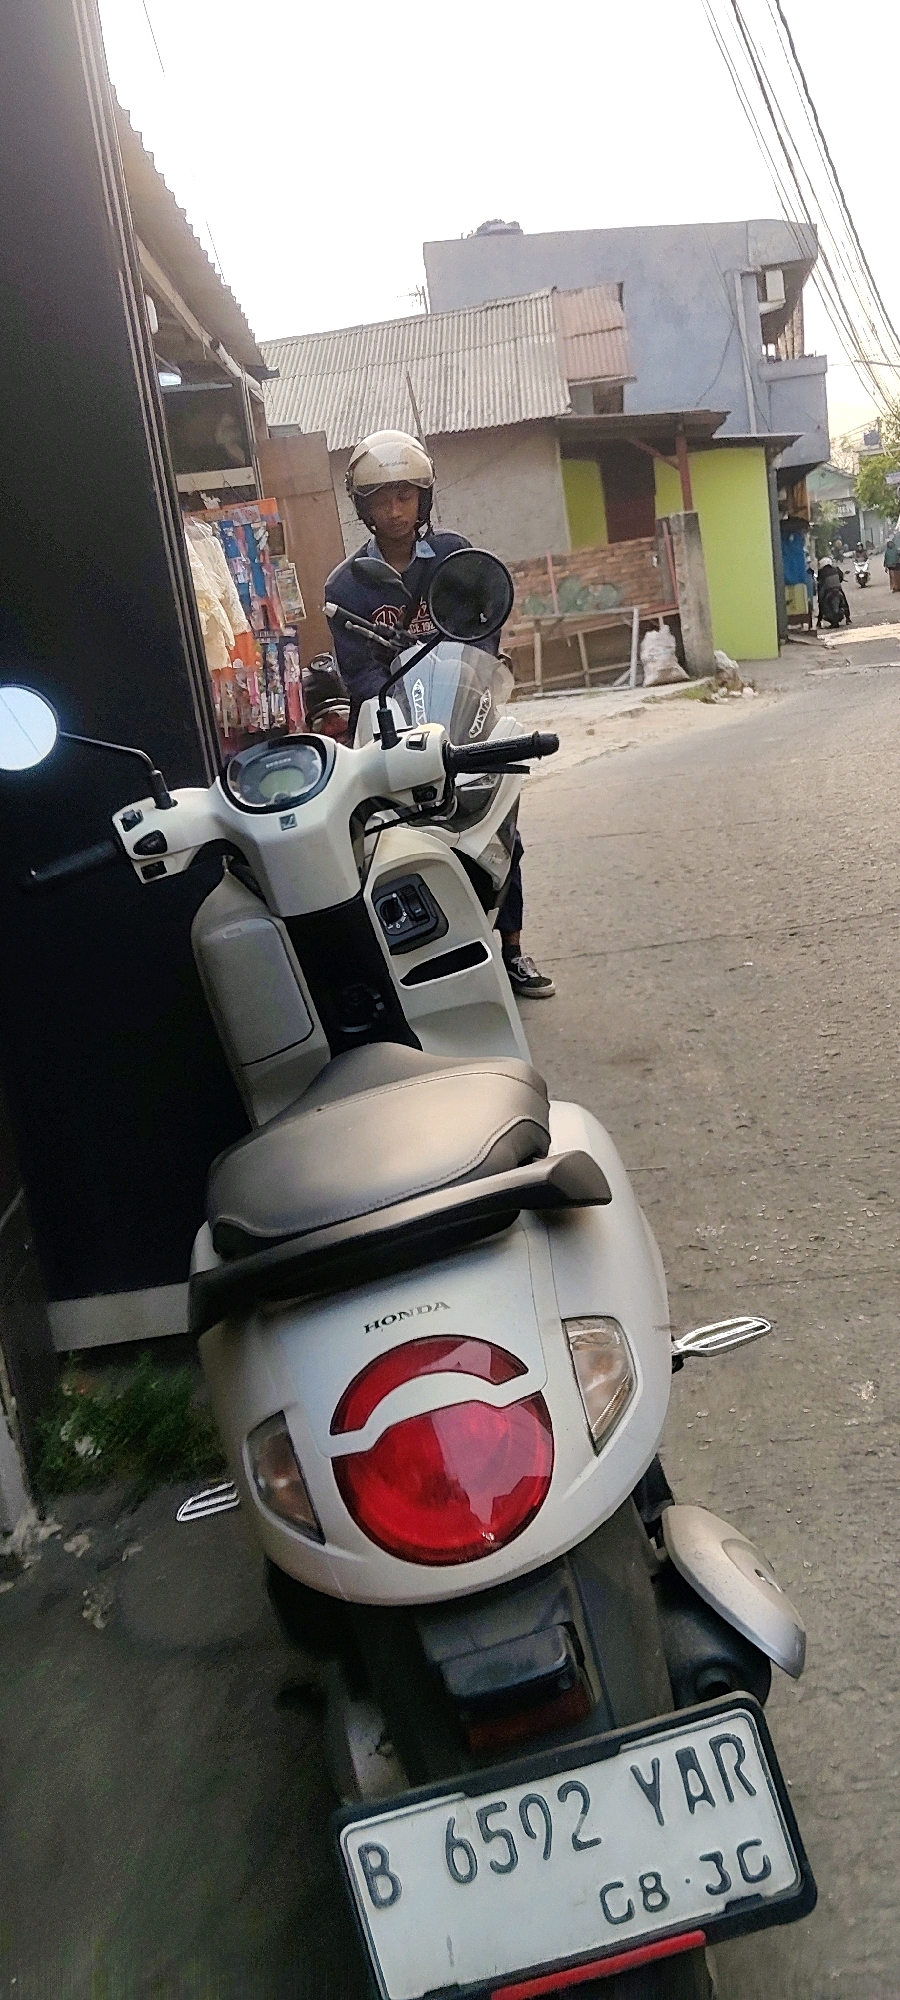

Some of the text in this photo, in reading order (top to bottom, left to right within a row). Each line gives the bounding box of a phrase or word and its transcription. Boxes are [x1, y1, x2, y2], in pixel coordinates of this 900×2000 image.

[363, 1301, 451, 1334] HONDA
[357, 1733, 757, 1909] B 6592 YAR
